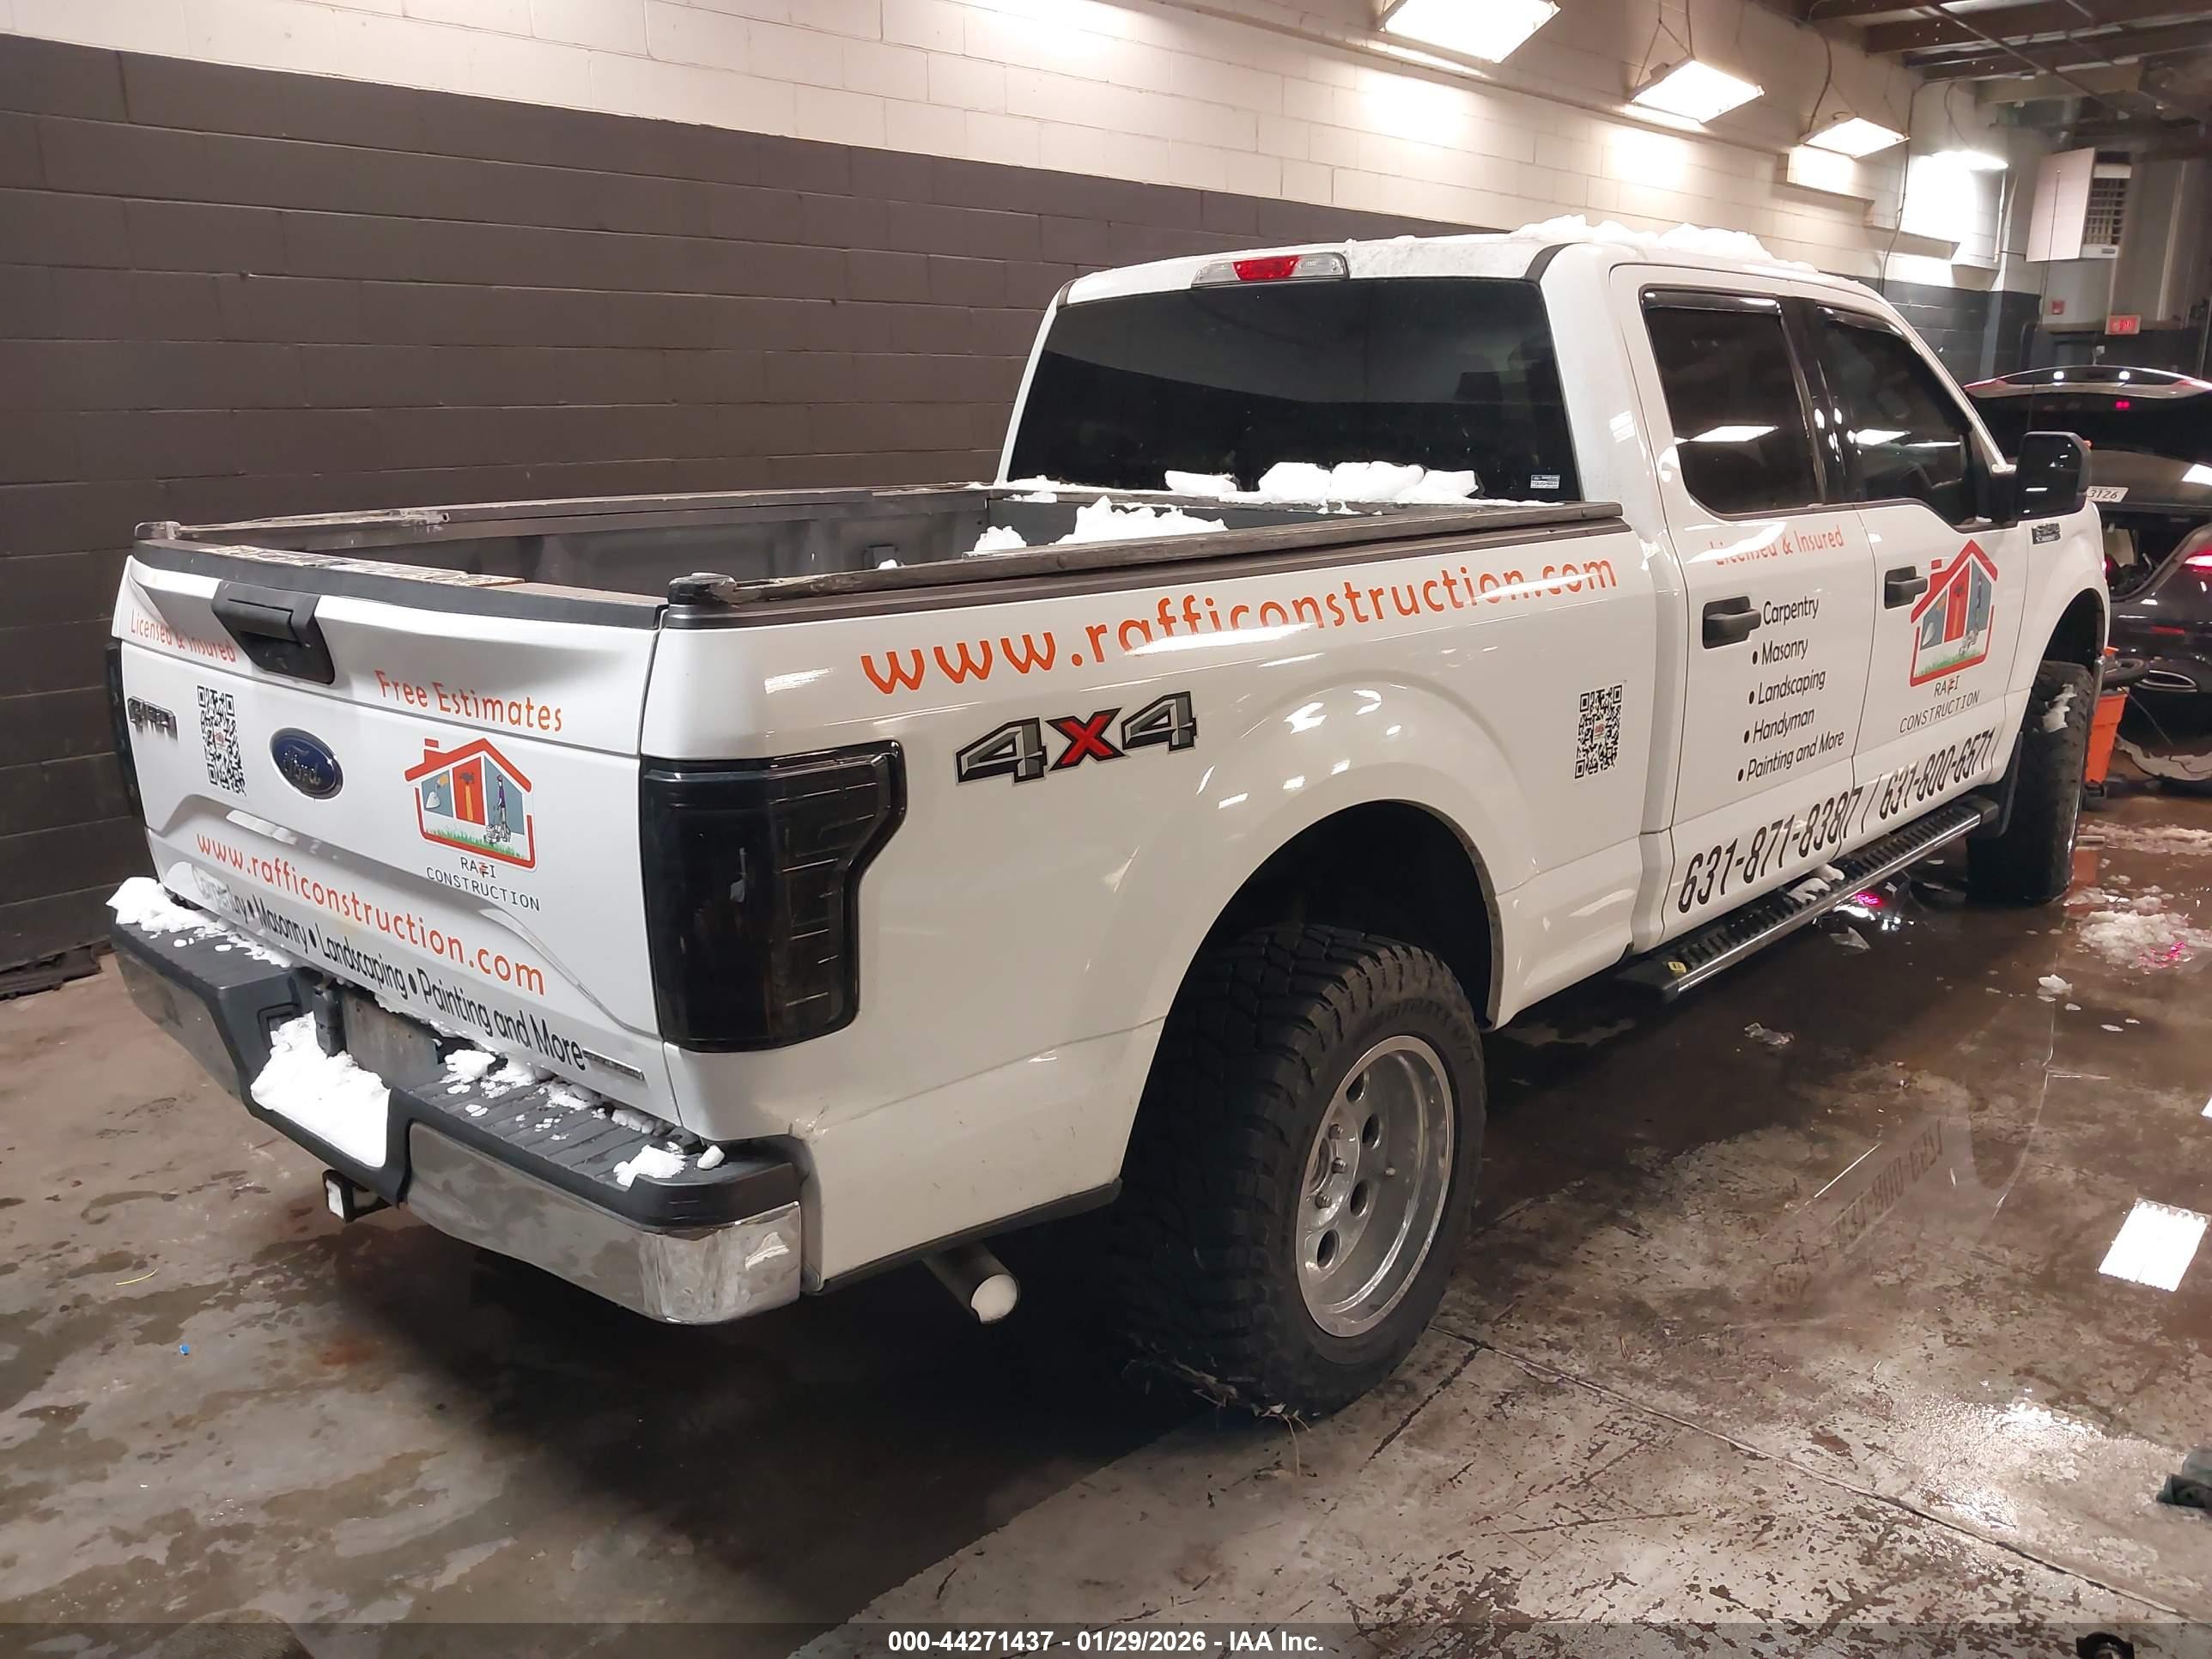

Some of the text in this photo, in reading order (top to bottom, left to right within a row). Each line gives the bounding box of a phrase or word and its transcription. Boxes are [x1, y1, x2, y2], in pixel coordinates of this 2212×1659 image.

[1782, 533, 1793, 555] &
[1794, 525, 1844, 552] Insured
[1763, 595, 1819, 625] Carpentry
[131, 608, 173, 646] Licensed
[188, 635, 236, 663] Insured
[1761, 639, 1808, 665] Masonry
[374, 670, 562, 732] Free Estimates
[1758, 669, 1826, 705] Landscaping
[1753, 708, 1814, 744] Handyman
[1899, 690, 1980, 733] CONSTRUCTION
[1747, 731, 1844, 781] Painting and More
[1678, 786, 1864, 914] 631-871-8387
[1879, 726, 1996, 820] 631-800-6571
[426, 866, 540, 911] CONSTRUCTION
[197, 834, 544, 995] www.rafficonstruction.com
[252, 894, 308, 954] Masonry
[315, 922, 408, 1000] Landscaping
[416, 967, 493, 1037] Painting
[494, 1010, 532, 1049] and
[529, 1013, 586, 1071] More
